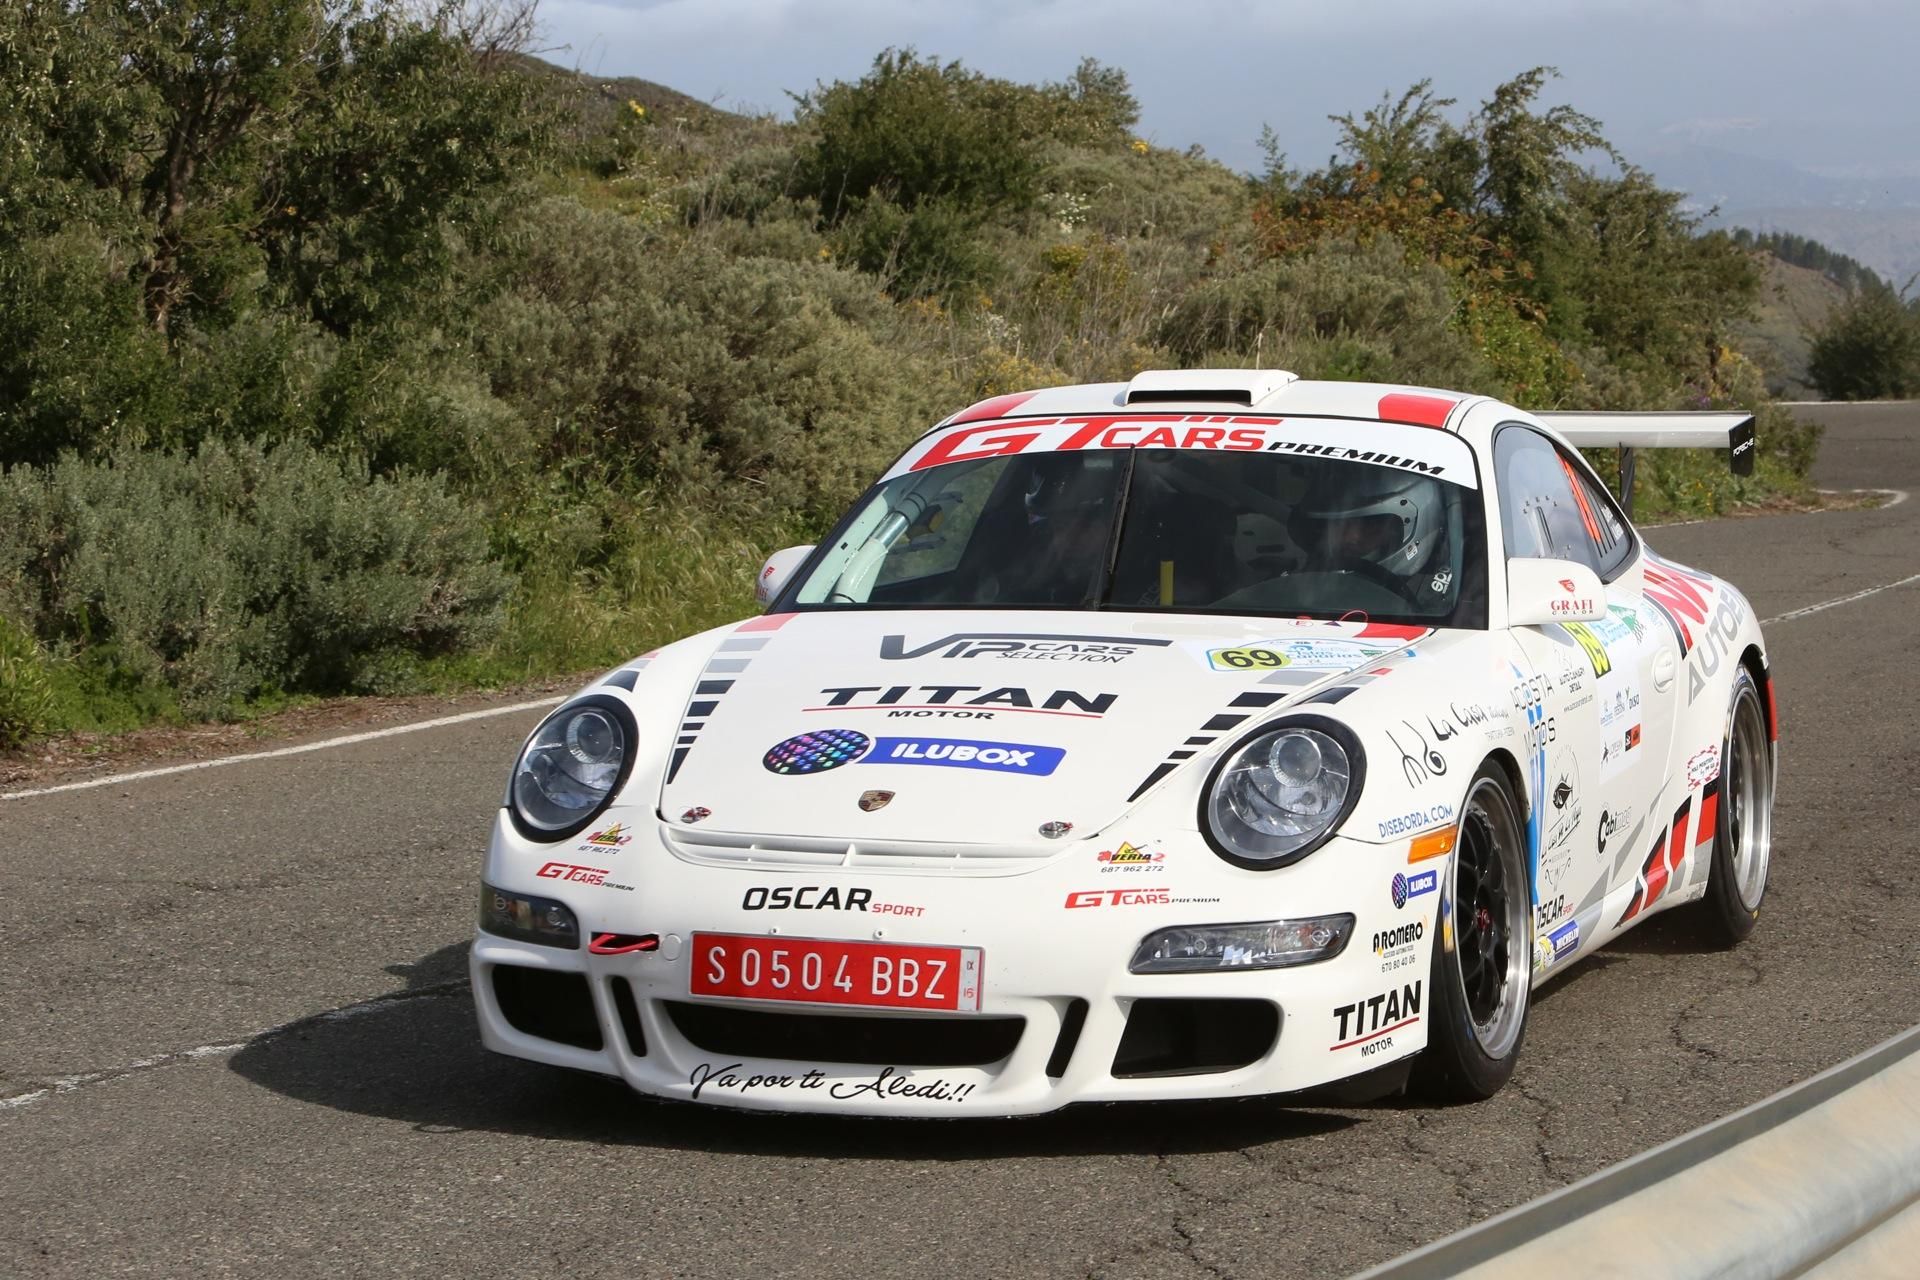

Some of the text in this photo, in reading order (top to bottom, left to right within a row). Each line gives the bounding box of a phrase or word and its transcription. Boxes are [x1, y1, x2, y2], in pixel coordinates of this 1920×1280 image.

[1267, 441, 1446, 476] PREMIUM
[1550, 599, 1594, 611] GRAFI
[996, 651, 1126, 664] SELECTION
[1028, 643, 1138, 656] CARS
[1220, 649, 1283, 668] 69
[821, 685, 1119, 714] TITAN
[1509, 672, 1555, 712] ACOSTA
[887, 710, 995, 720] MOTOR
[890, 743, 1035, 768] ILUBOX
[1378, 803, 1454, 838] DISEBORDA.COM
[1410, 876, 1434, 893] ILUBOX
[742, 886, 926, 918] OSCAR SPORT
[707, 946, 947, 999] S 0504 BBZ
[963, 987, 975, 999] 16
[1333, 979, 1422, 1041] TITAN
[1361, 1036, 1394, 1058] MOTOR
[740, 1074, 794, 1093] por
[799, 1069, 826, 1089] ti
[829, 1066, 977, 1103] Aledi!!
